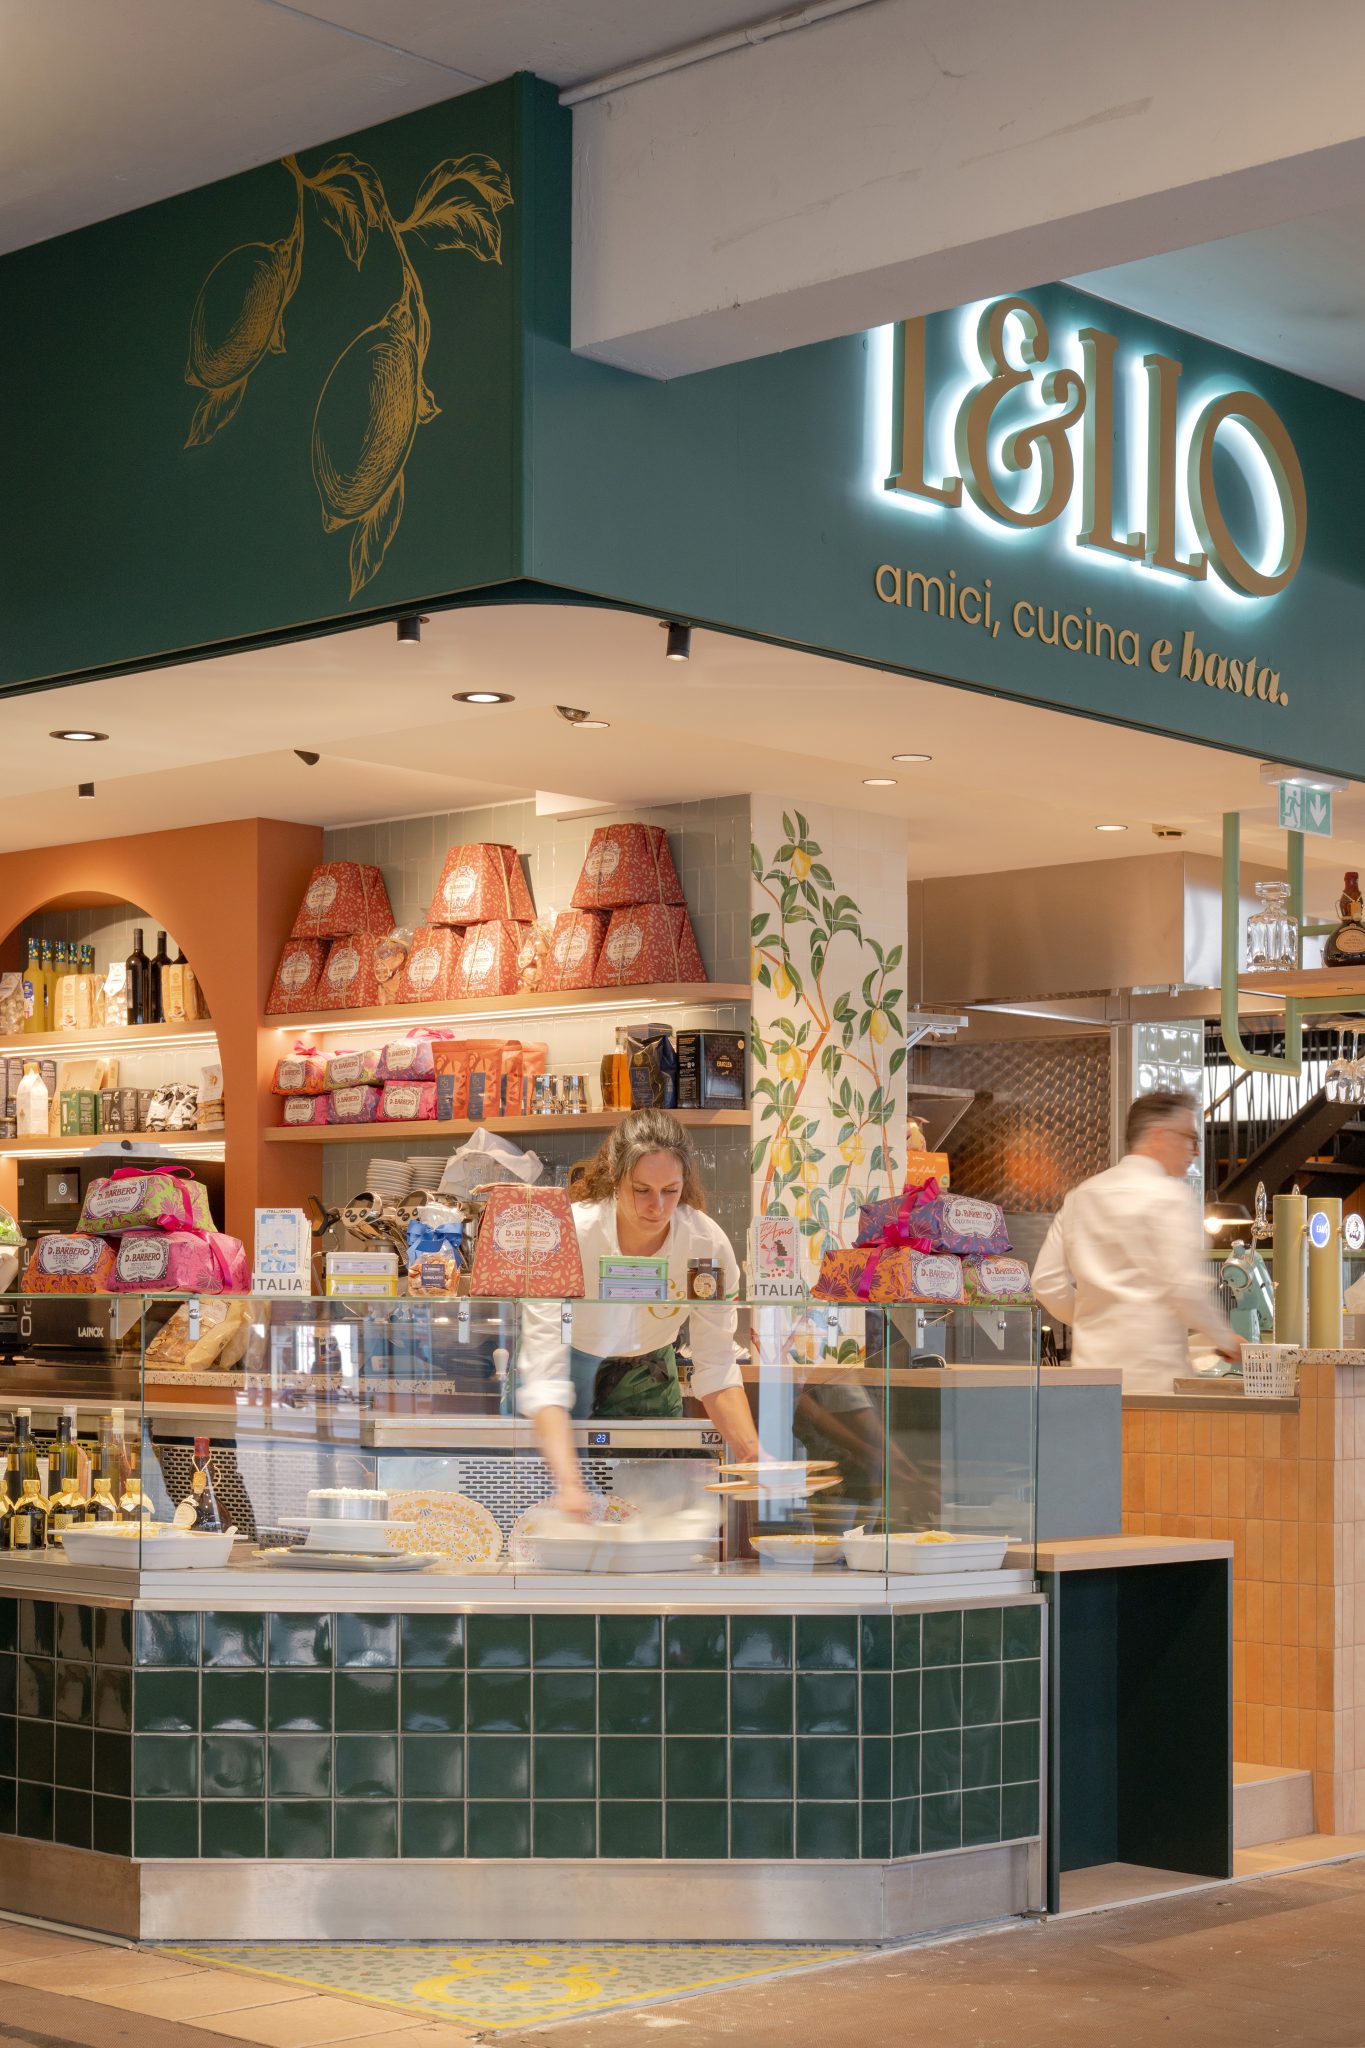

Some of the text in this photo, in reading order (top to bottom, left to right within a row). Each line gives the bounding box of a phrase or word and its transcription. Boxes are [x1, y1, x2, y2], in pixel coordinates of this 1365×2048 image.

[875, 563, 1289, 706] amici, cucina e basta.
[252, 1279, 302, 1291] ITALIA
[754, 1284, 804, 1297] ITALIA
[78, 1326, 104, 1338] LAINOX
[596, 1434, 606, 1443] 23
